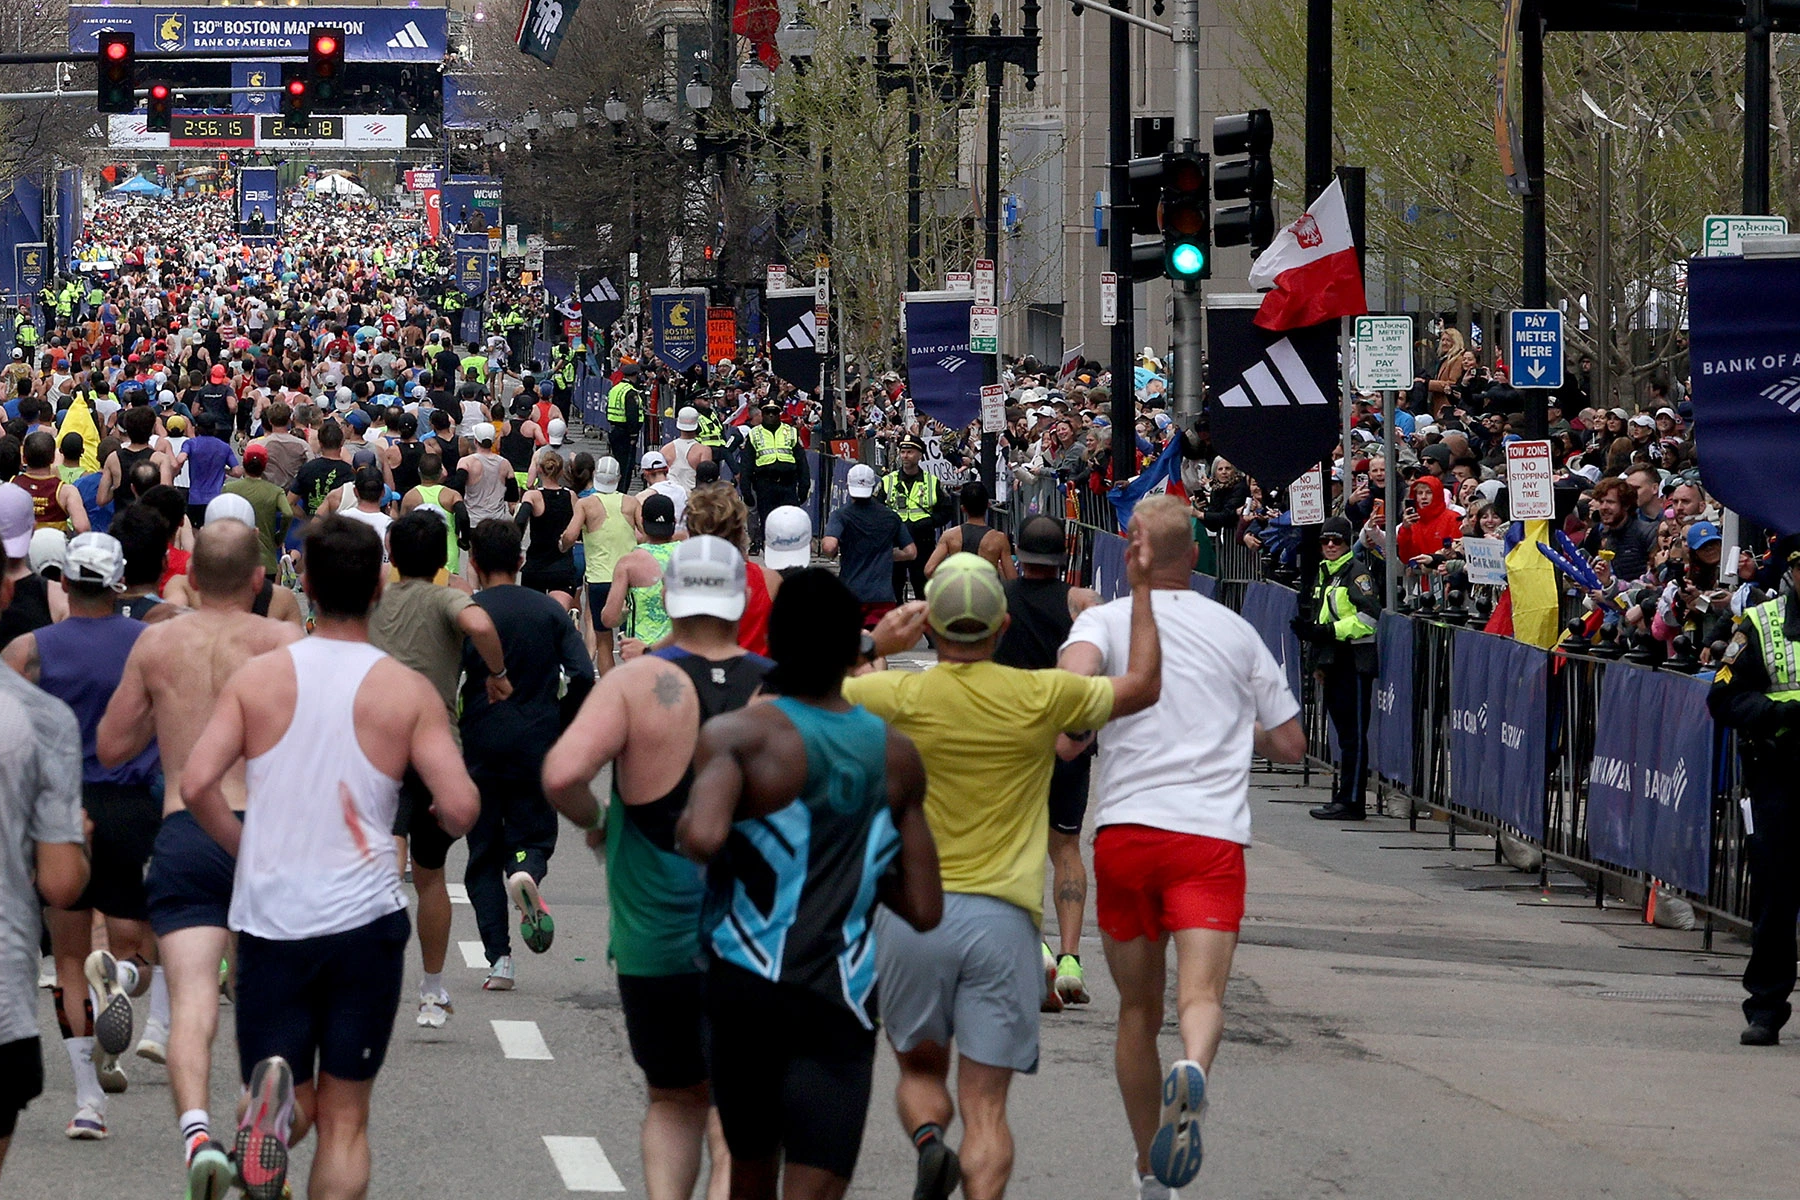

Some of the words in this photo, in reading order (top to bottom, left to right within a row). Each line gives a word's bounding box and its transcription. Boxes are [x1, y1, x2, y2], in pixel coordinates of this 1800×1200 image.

[224, 20, 280, 34] BOSTON
[194, 38, 224, 46] BANK
[226, 38, 240, 47] OF
[241, 38, 292, 47] AMERICA
[185, 120, 241, 136] 2:56:15
[1710, 221, 1727, 238] 2
[1732, 224, 1780, 232] PARKING
[711, 322, 733, 331] STEEL
[1525, 316, 1547, 328] PAY
[1360, 321, 1371, 335] 2
[710, 336, 733, 344] PLATES
[1516, 331, 1556, 343] METER
[711, 348, 733, 356] AHEAD
[912, 346, 935, 354] BANK
[1521, 346, 1552, 357] HERE
[1703, 358, 1757, 375] BANK
[1762, 354, 1787, 369] OF
[1509, 447, 1524, 456] TOW
[1526, 446, 1547, 456] ZONE
[1522, 462, 1536, 471] NO
[1512, 472, 1548, 480] STOPPING
[1293, 484, 1320, 492] STOPPING
